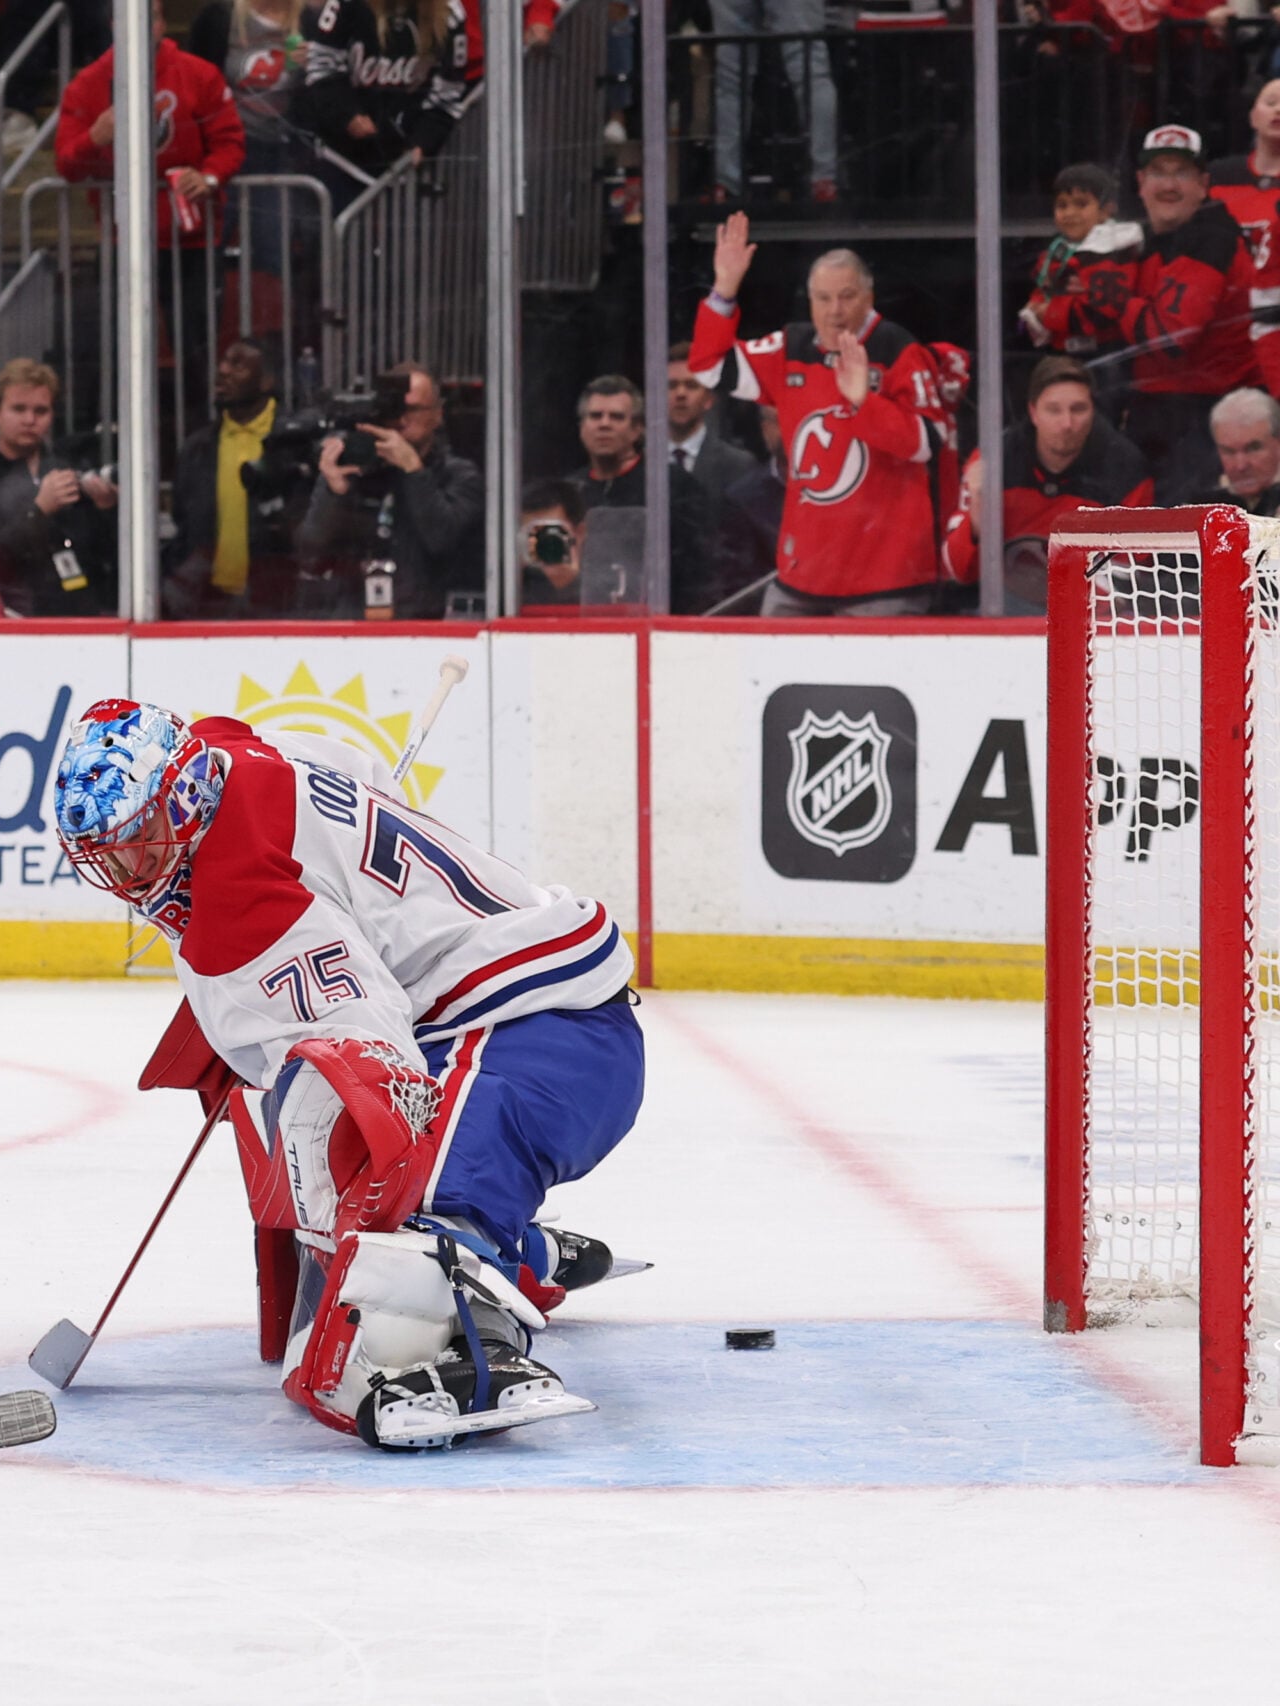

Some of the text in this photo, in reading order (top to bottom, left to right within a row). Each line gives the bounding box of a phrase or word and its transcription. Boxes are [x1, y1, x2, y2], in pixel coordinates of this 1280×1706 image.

[811, 749, 871, 820] NHL
[259, 940, 367, 1023] 75
[288, 1141, 309, 1226] TRUE
